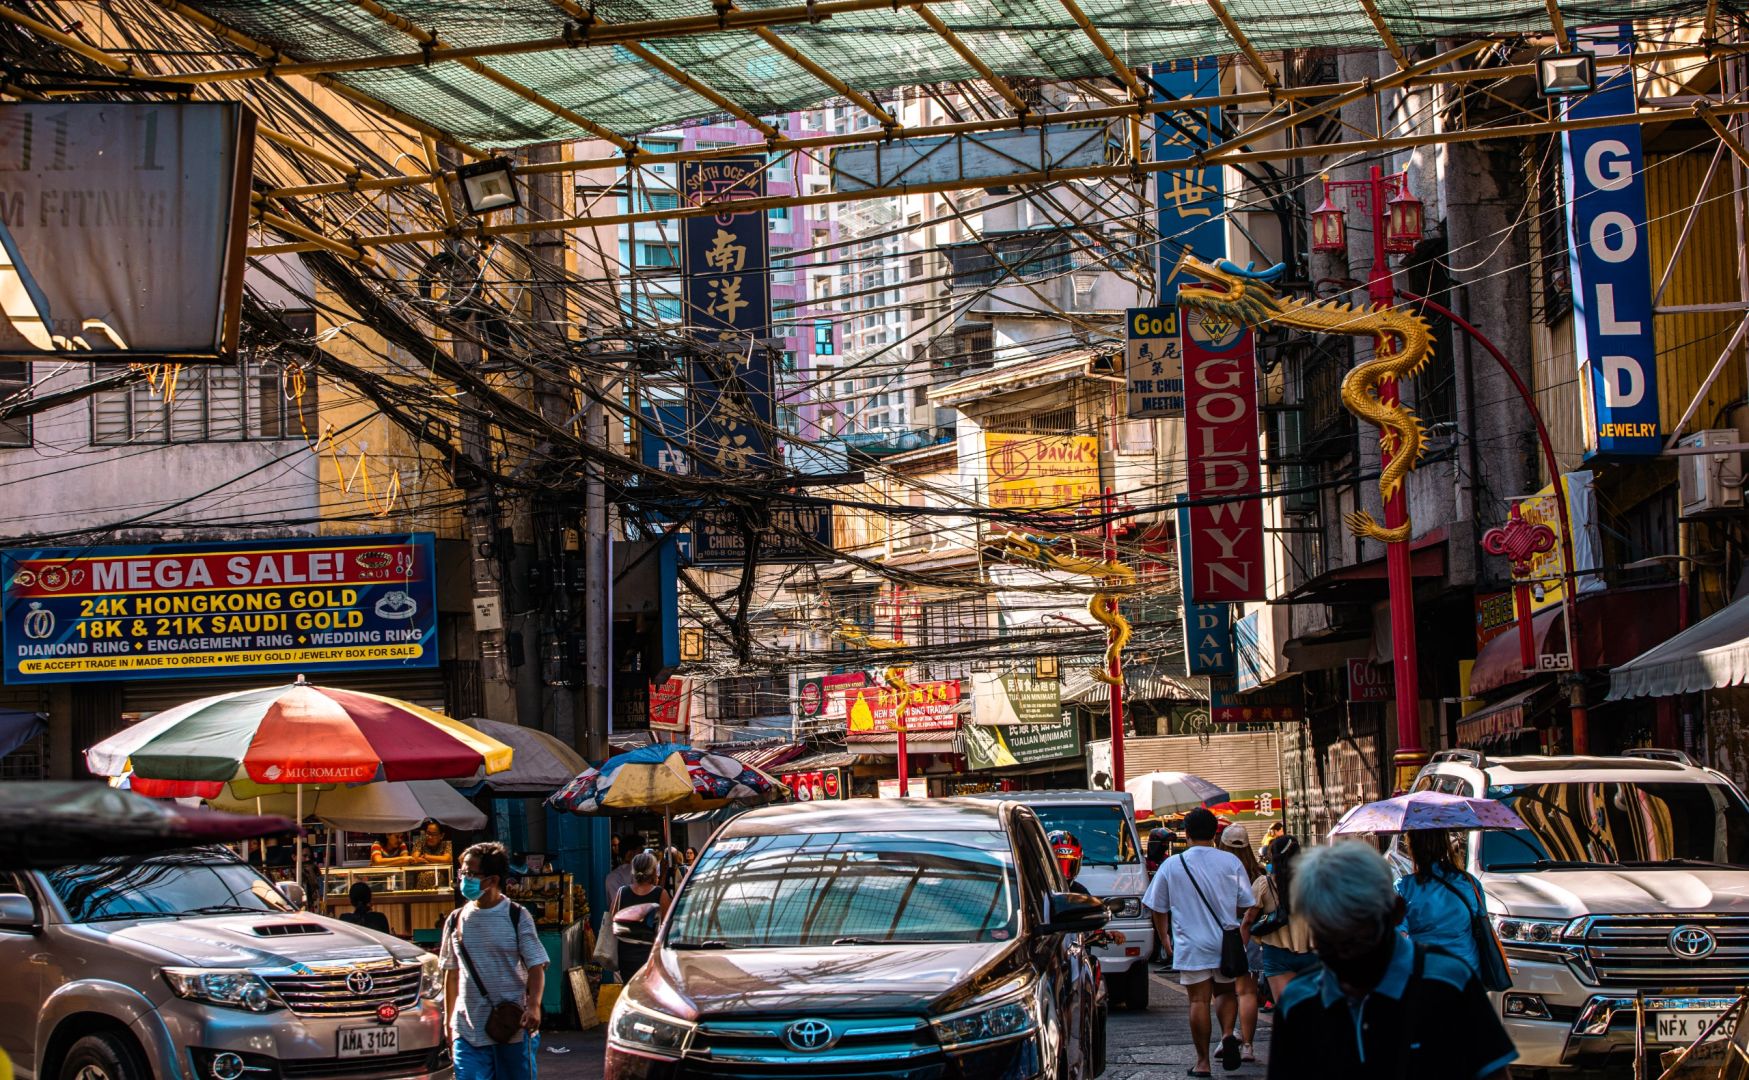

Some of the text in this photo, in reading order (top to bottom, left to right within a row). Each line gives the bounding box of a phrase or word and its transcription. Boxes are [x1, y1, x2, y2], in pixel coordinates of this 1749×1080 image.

[687, 165, 760, 190] SOUTH OCEAN
[1583, 139, 1645, 409] GOLD
[1134, 312, 1176, 336] God
[1133, 380, 1153, 393] THE
[1599, 422, 1657, 439] JEWELRY
[1194, 358, 1254, 594] GOLDWYN
[92, 553, 345, 591] MEGA SALE!
[80, 589, 358, 617] 24K HONGKONG GOLD
[76, 610, 364, 639] 18K & 21K SAUDI GOLD
[18, 628, 423, 657] DIAMOND RING ENGAGEMENT RING WEDDING RING
[27, 662, 42, 671] WE
[44, 661, 82, 670] ACCEPT
[85, 659, 117, 668] TRADE
[119, 658, 128, 667] IN
[136, 657, 164, 666] MADE
[166, 657, 179, 665] TO
[181, 655, 214, 665] ORDER
[225, 655, 239, 663] WE
[242, 653, 262, 662] BUY
[264, 652, 291, 661] GOLD
[298, 650, 343, 660] JEWELRY
[345, 649, 366, 658] BOX
[368, 648, 388, 657] FOR
[390, 647, 415, 656] SALE
[1010, 729, 1073, 747] TUALIAN MINIMART
[286, 767, 363, 778] MICROMATIC
[1254, 792, 1275, 817] 通
[367, 1031, 396, 1048] 3102
[1660, 1019, 1687, 1036] NFX
